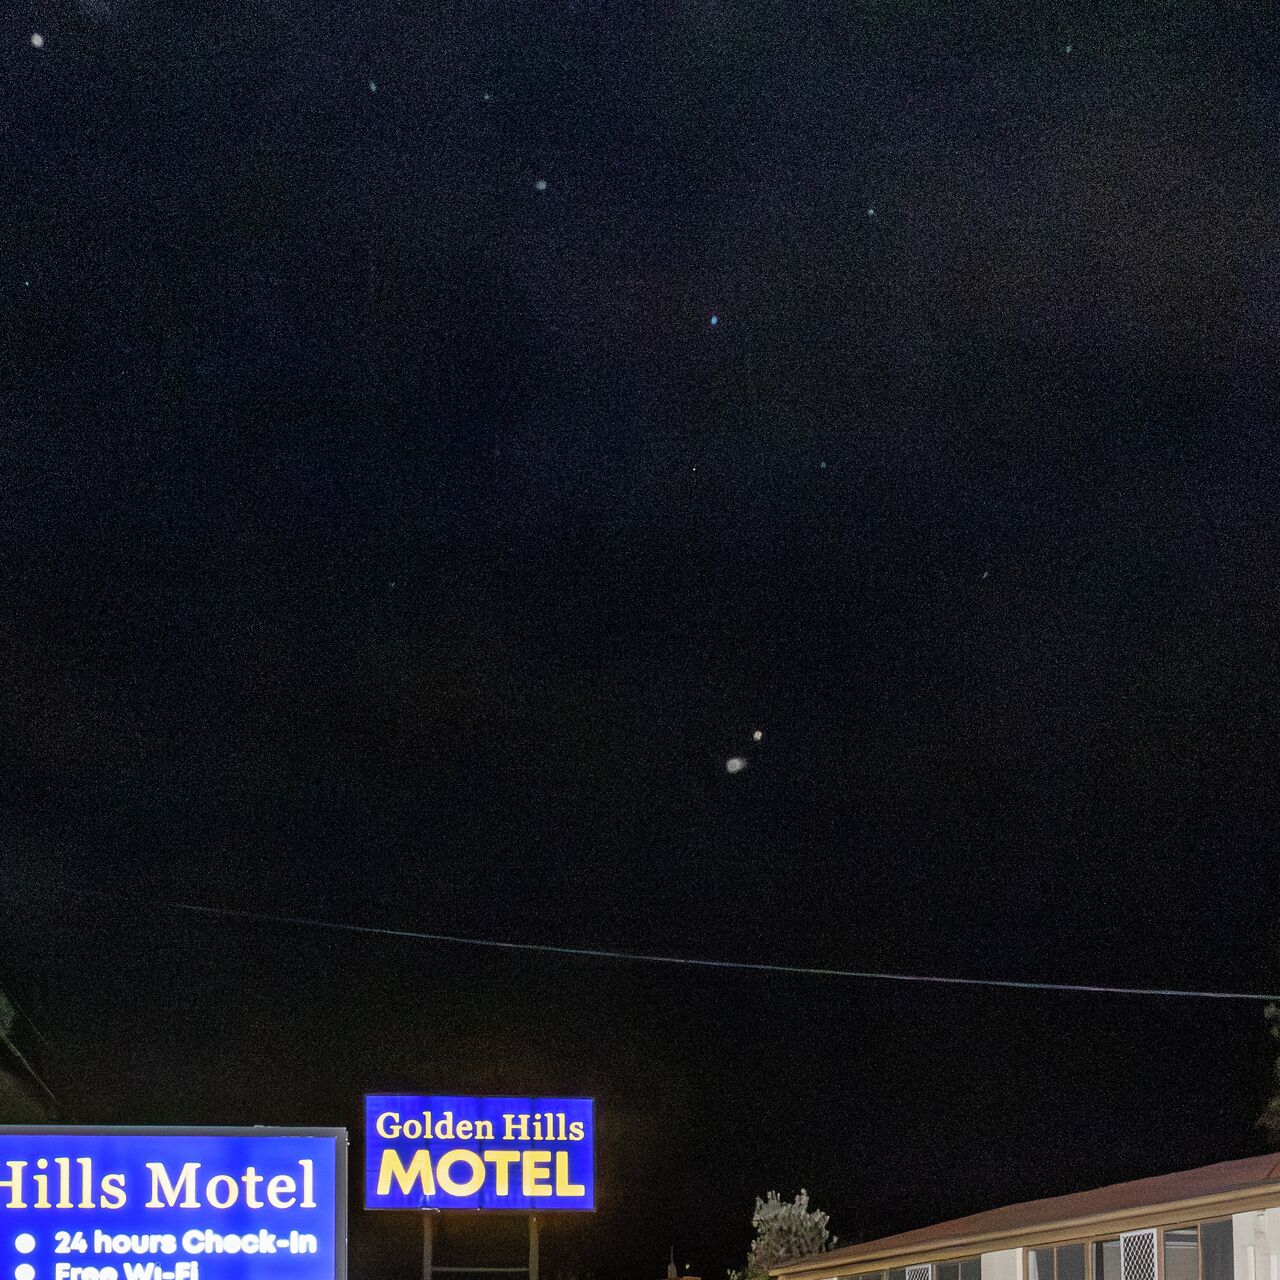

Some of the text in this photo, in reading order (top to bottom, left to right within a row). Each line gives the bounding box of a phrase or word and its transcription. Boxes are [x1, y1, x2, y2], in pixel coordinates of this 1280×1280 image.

[376, 1111, 585, 1141] Golden Hills
[145, 1159, 317, 1209] Motel
[376, 1149, 586, 1197] MOTEL
[53, 1229, 318, 1254] 24 hours Check-In
